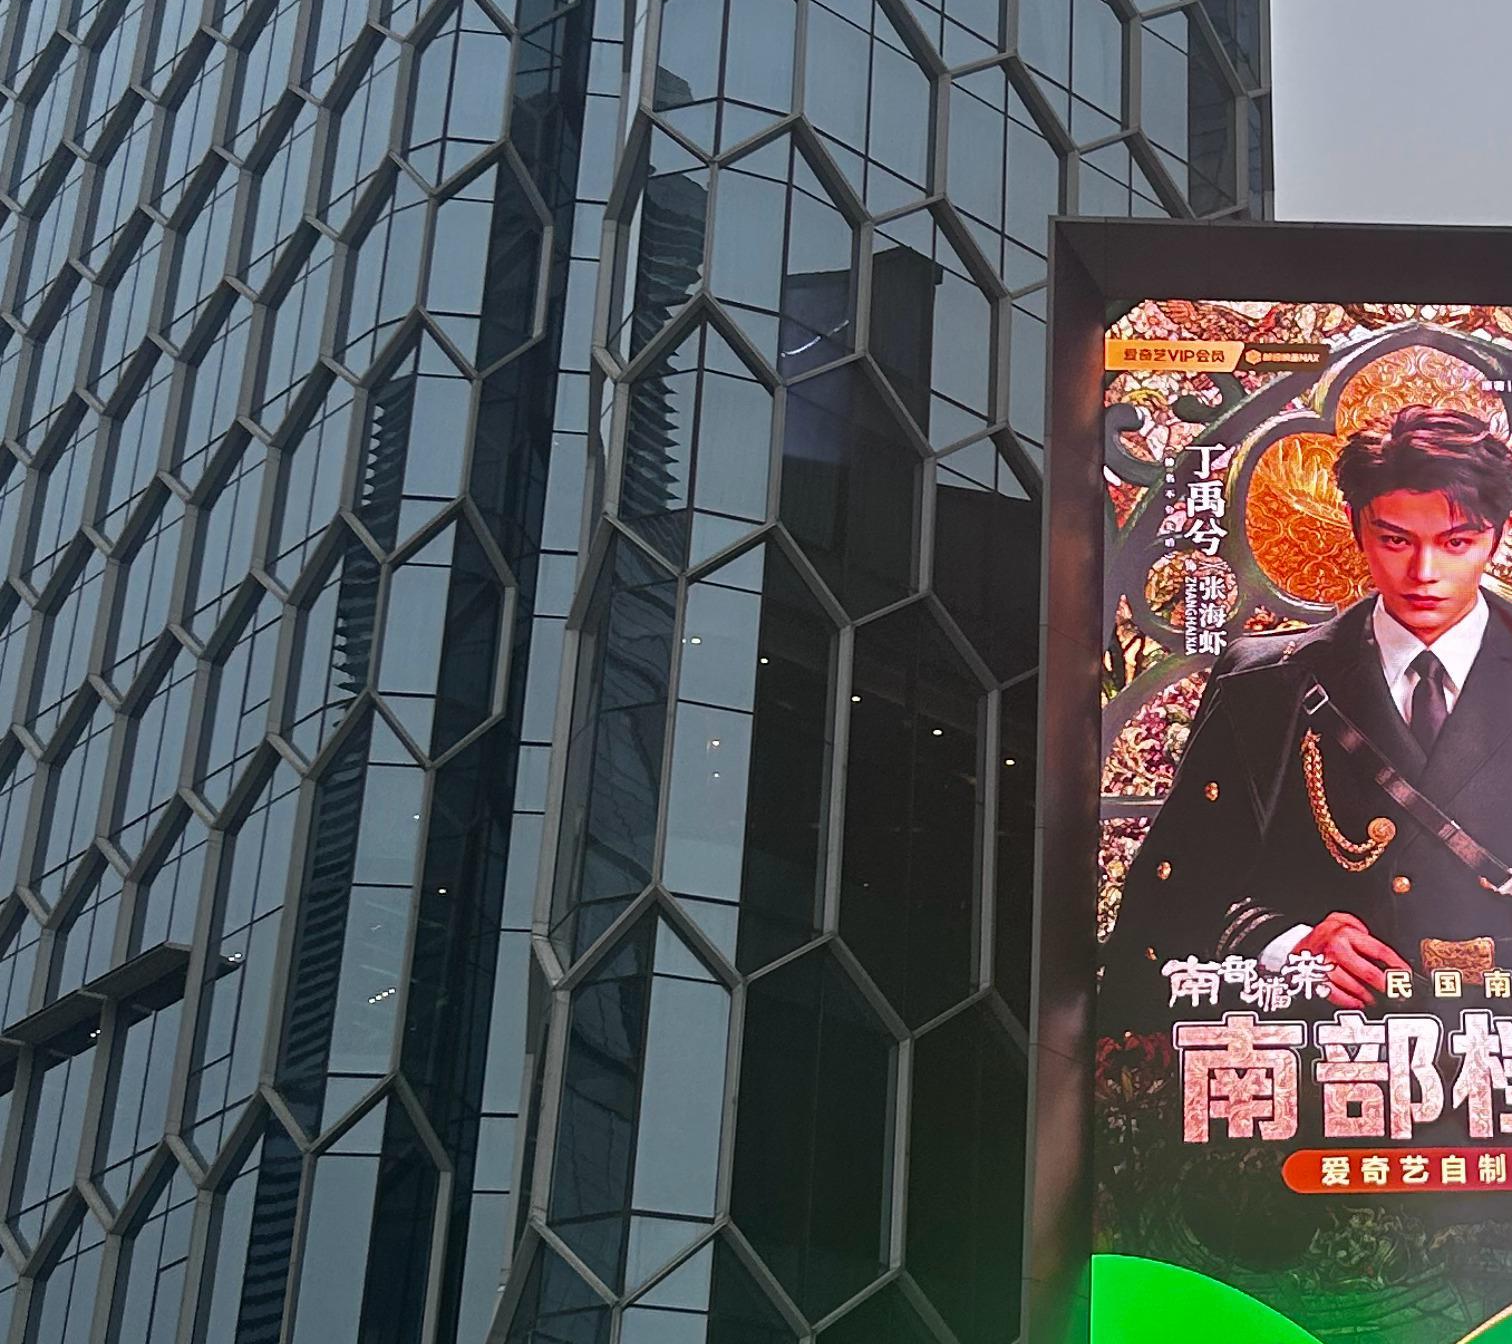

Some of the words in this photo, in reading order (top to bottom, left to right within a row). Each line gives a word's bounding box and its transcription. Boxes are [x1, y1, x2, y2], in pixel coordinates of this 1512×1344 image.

[1184, 443, 1228, 556] 丁禹兮
[1199, 575, 1228, 656] 张海虾
